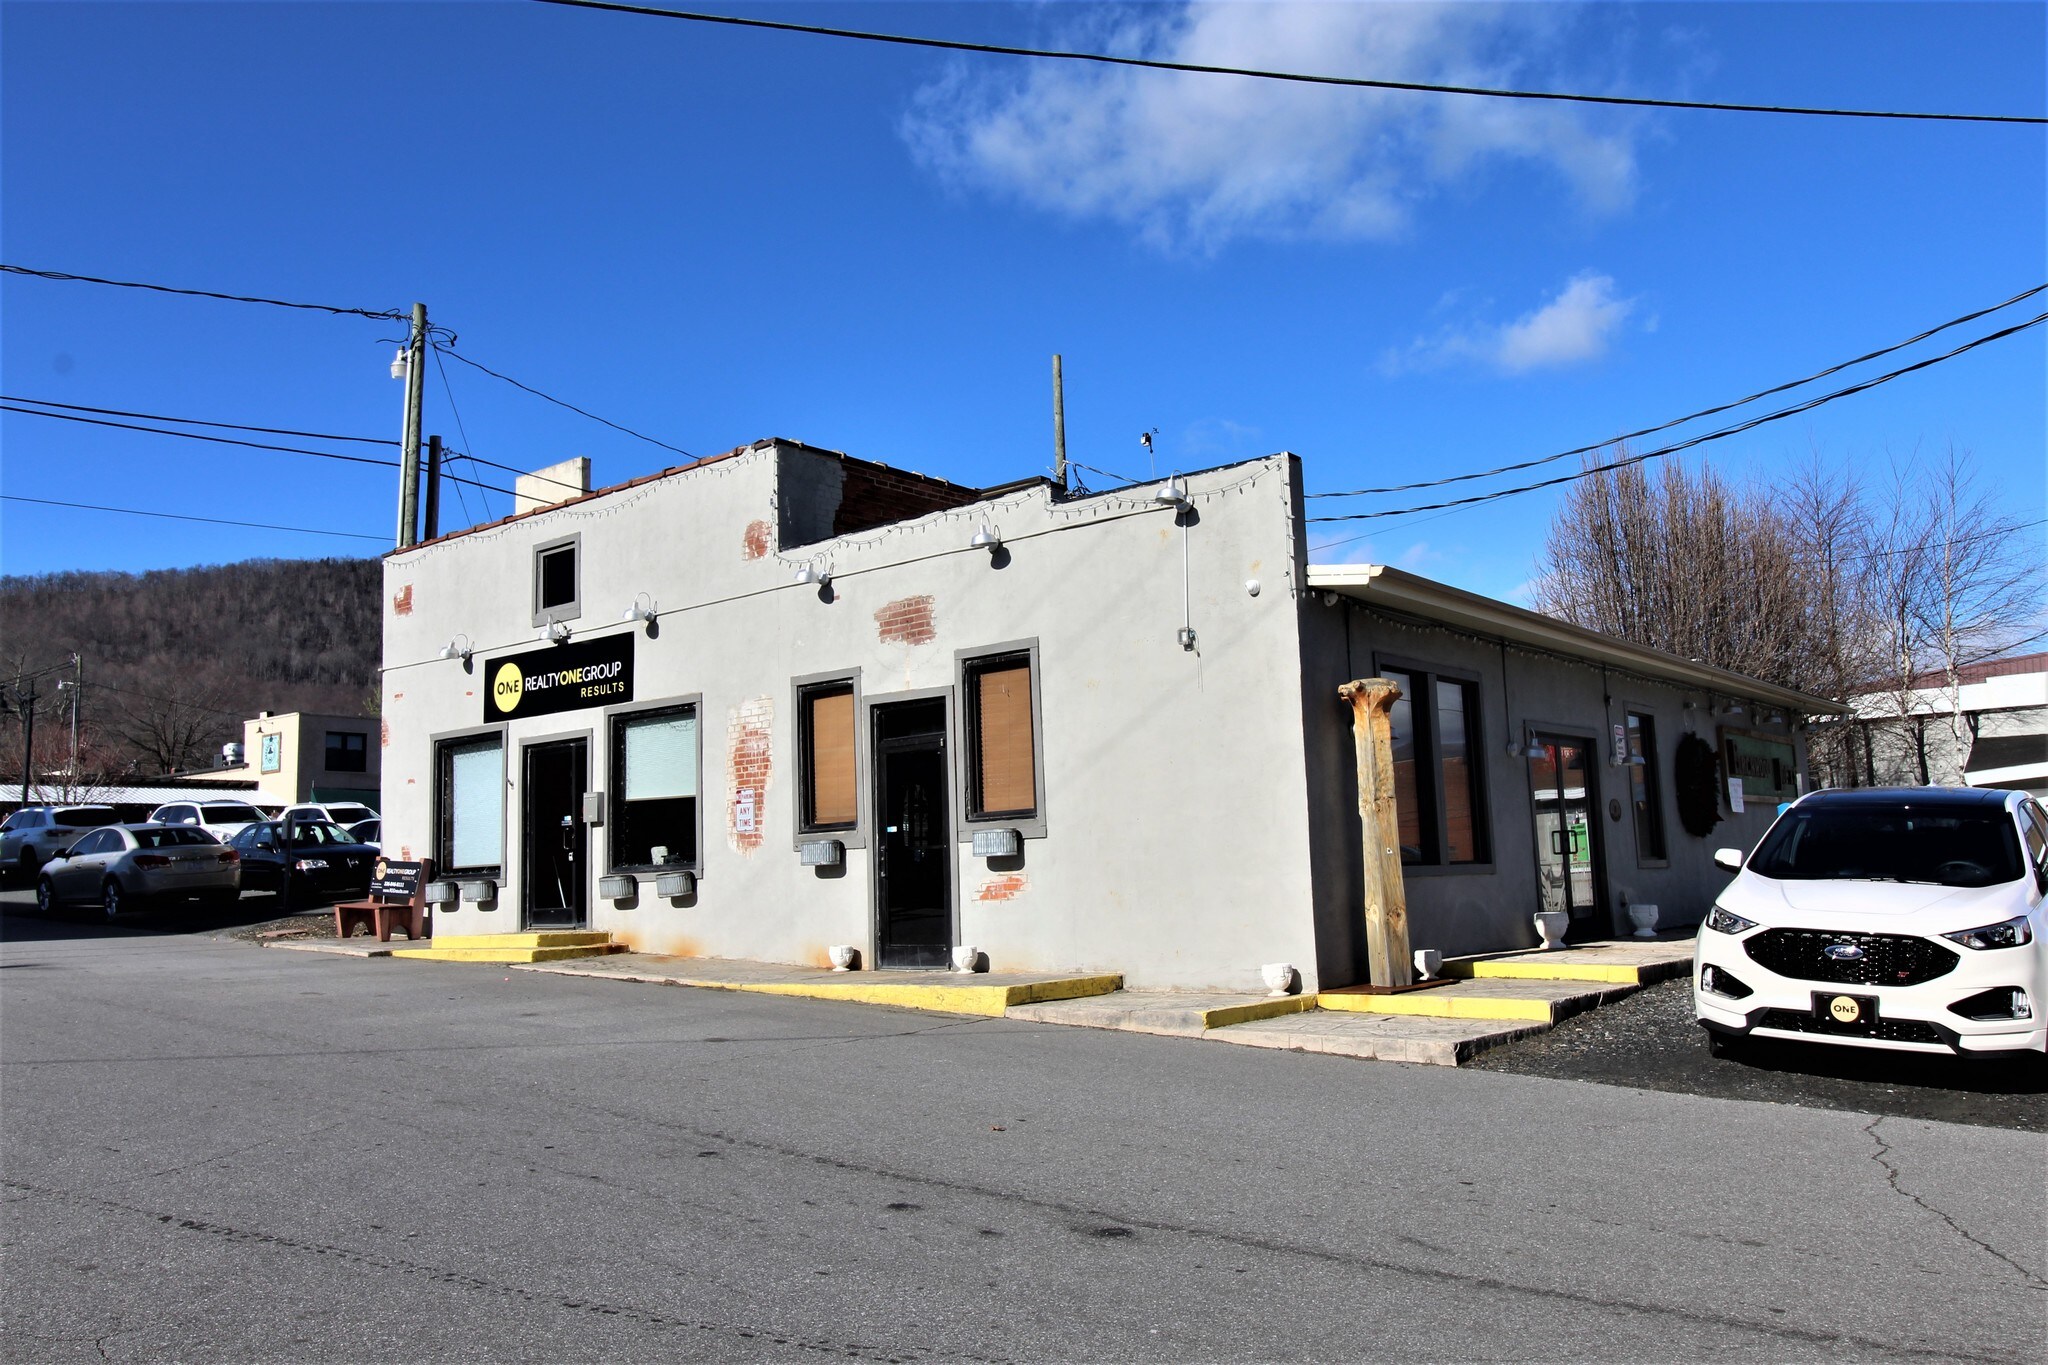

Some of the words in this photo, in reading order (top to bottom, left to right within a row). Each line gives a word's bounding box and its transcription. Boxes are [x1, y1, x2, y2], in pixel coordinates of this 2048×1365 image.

[497, 679, 520, 695] ONE
[580, 681, 625, 698] RESULTS
[740, 806, 751, 815] ANY
[739, 818, 751, 827] TIME
[1833, 1004, 1856, 1014] ONE
